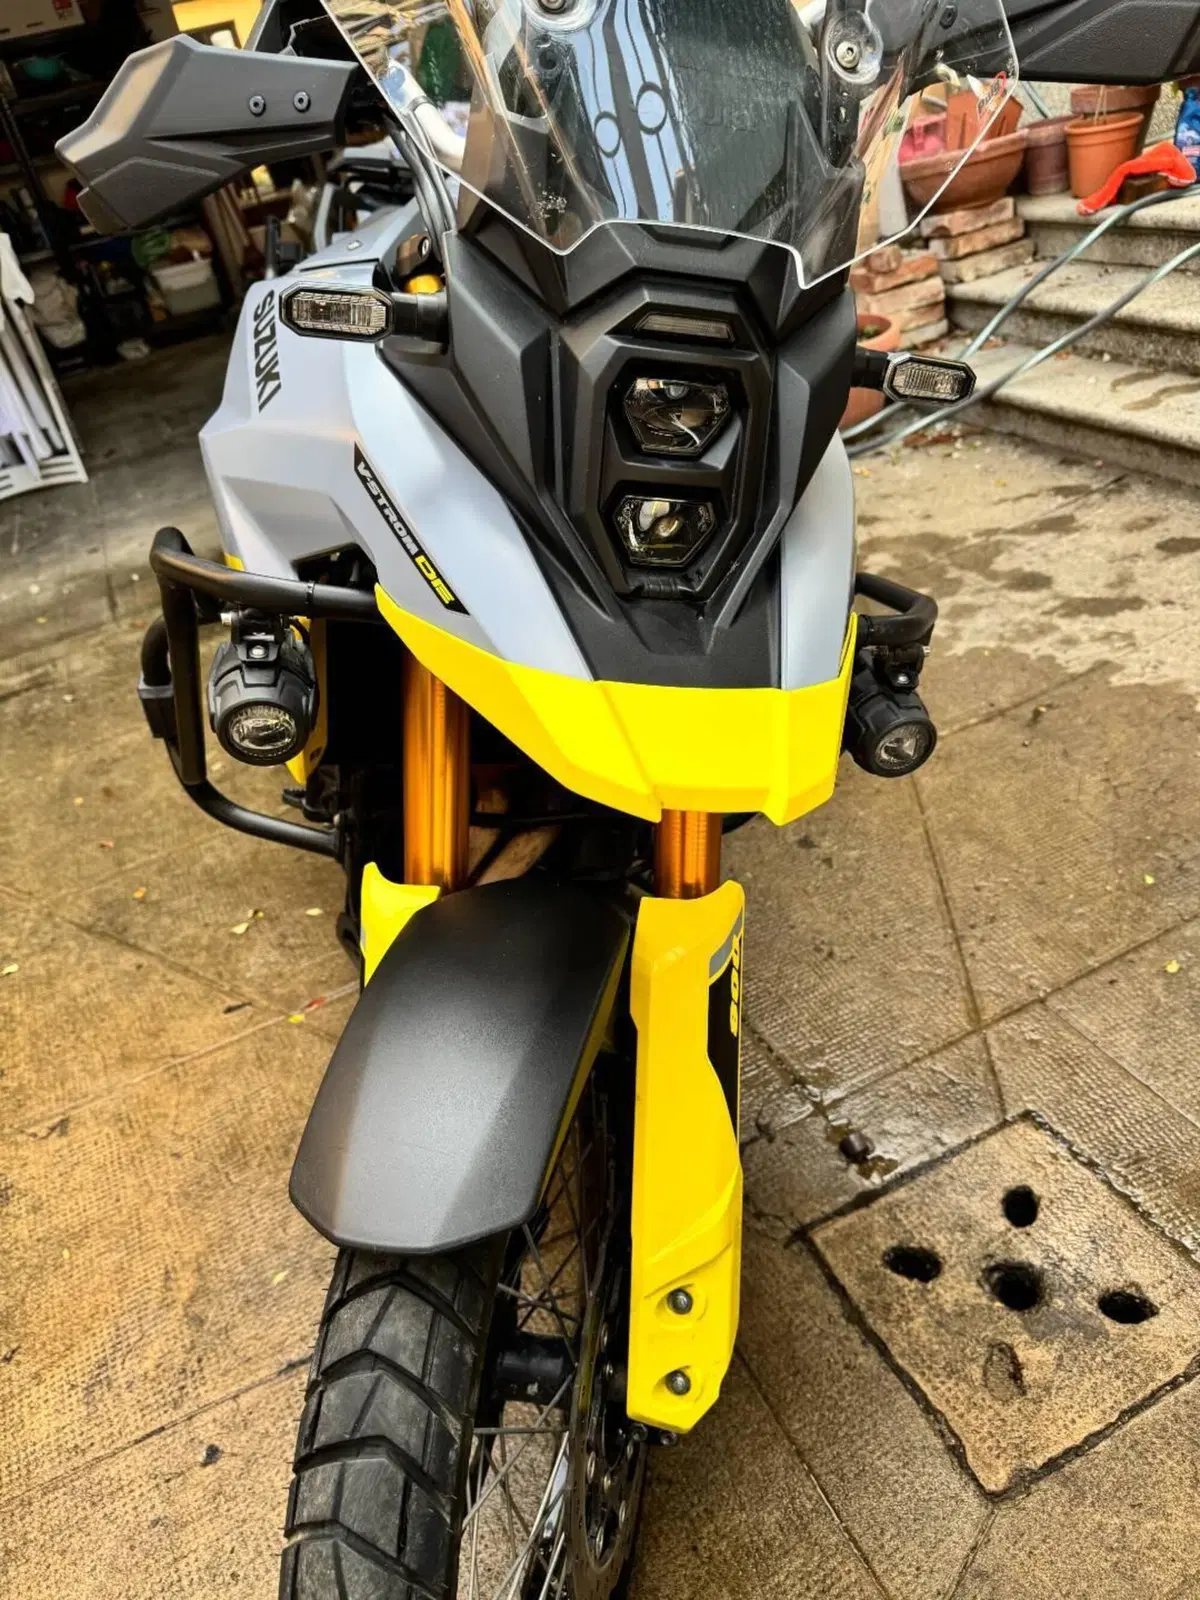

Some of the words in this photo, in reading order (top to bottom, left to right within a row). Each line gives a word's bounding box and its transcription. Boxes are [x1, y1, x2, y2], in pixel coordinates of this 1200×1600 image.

[254, 290, 281, 413] SUZUKI
[357, 462, 419, 556] V-STROM
[414, 555, 455, 604] DE
